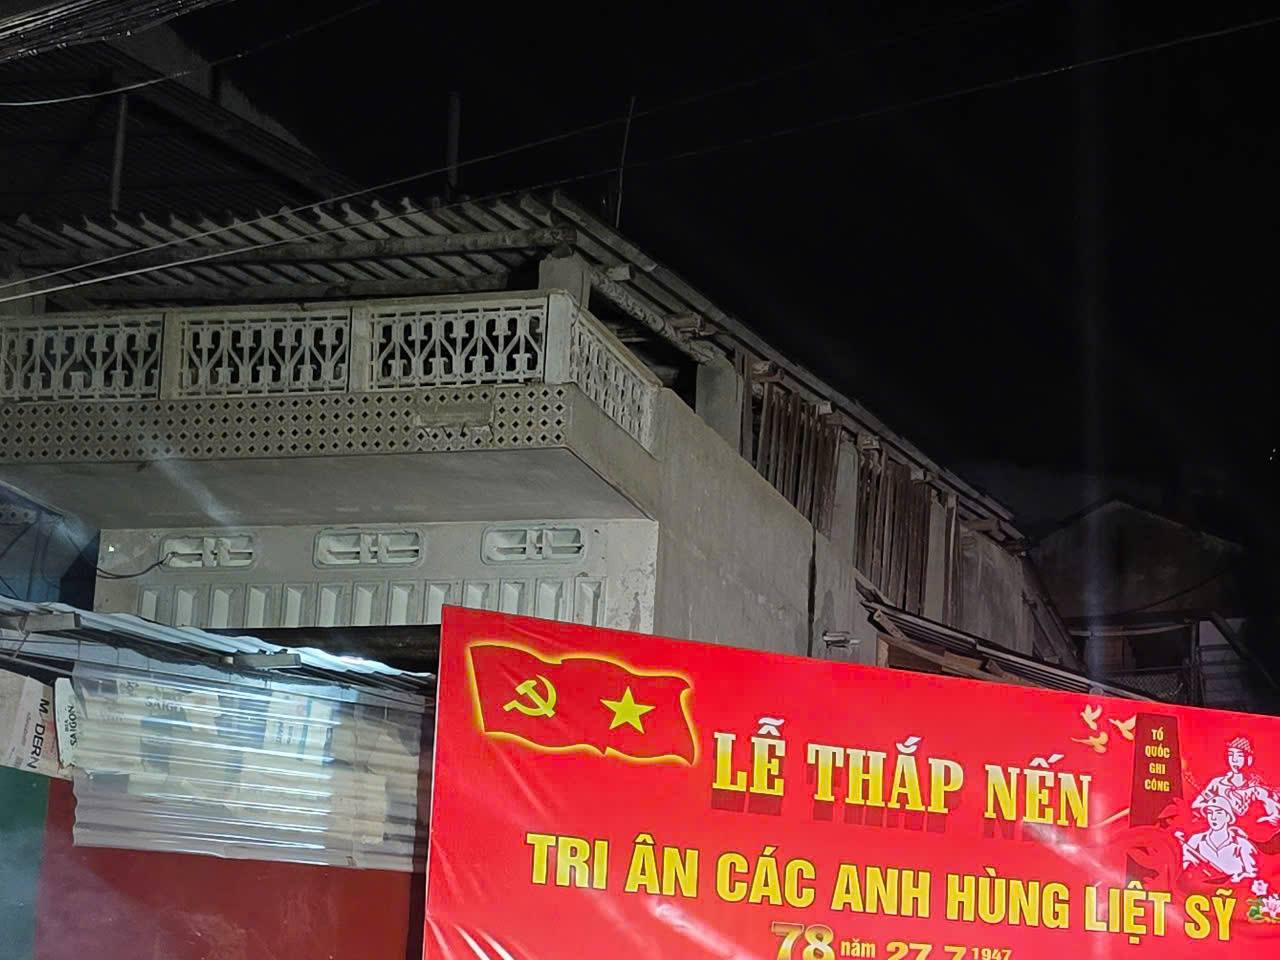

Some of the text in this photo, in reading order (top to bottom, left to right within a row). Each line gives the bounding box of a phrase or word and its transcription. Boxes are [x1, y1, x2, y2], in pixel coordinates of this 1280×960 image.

[27, 698, 50, 769] MDERN
[712, 717, 1092, 828] LỄ THẮP NẾN
[1144, 777, 1170, 792] CÔNG
[1149, 762, 1166, 775] GHI
[525, 832, 1237, 945] TRI ÂN CÁC ANH HÙNG LIỆT SỸ
[840, 938, 876, 959] năm
